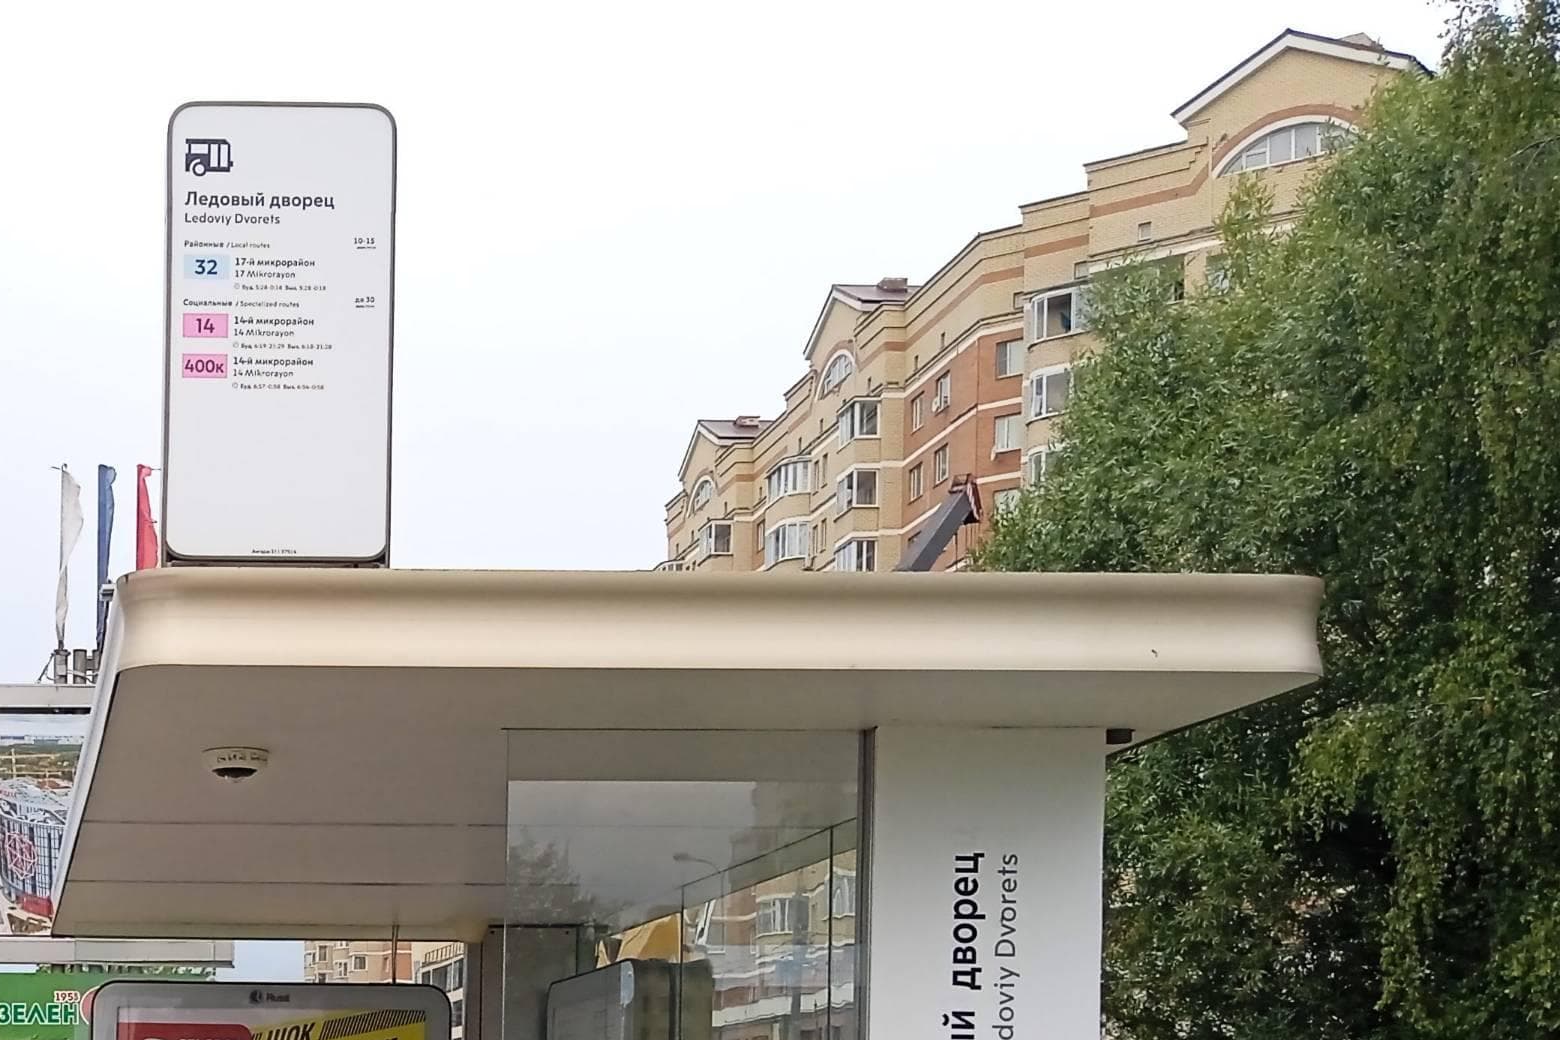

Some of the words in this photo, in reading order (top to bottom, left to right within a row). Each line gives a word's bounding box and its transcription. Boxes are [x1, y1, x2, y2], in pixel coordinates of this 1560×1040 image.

[184, 191, 265, 208] Ледовый
[269, 195, 335, 210] дворец
[184, 213, 231, 225] Ledoviy
[234, 213, 281, 224] Dvorets
[184, 240, 224, 248] Районные
[194, 259, 218, 275] 32
[235, 257, 255, 266] 17-й
[256, 258, 316, 269] микрорайон
[235, 270, 245, 278] 17
[246, 270, 296, 280] Mikrorayon
[183, 298, 233, 307] Социальные
[196, 318, 215, 334] 14
[234, 316, 254, 325] 14-й
[256, 317, 315, 327] микрорайон
[234, 329, 244, 337] 14
[246, 329, 295, 339] Mikrorayon
[185, 360, 224, 374] 400к
[233, 357, 253, 365] 14-й
[255, 357, 314, 367] микрорайон
[233, 369, 243, 377] 14
[244, 370, 294, 379] Mikrorayon
[995, 852, 1018, 958] Dvorets
[952, 852, 986, 990] дворец
